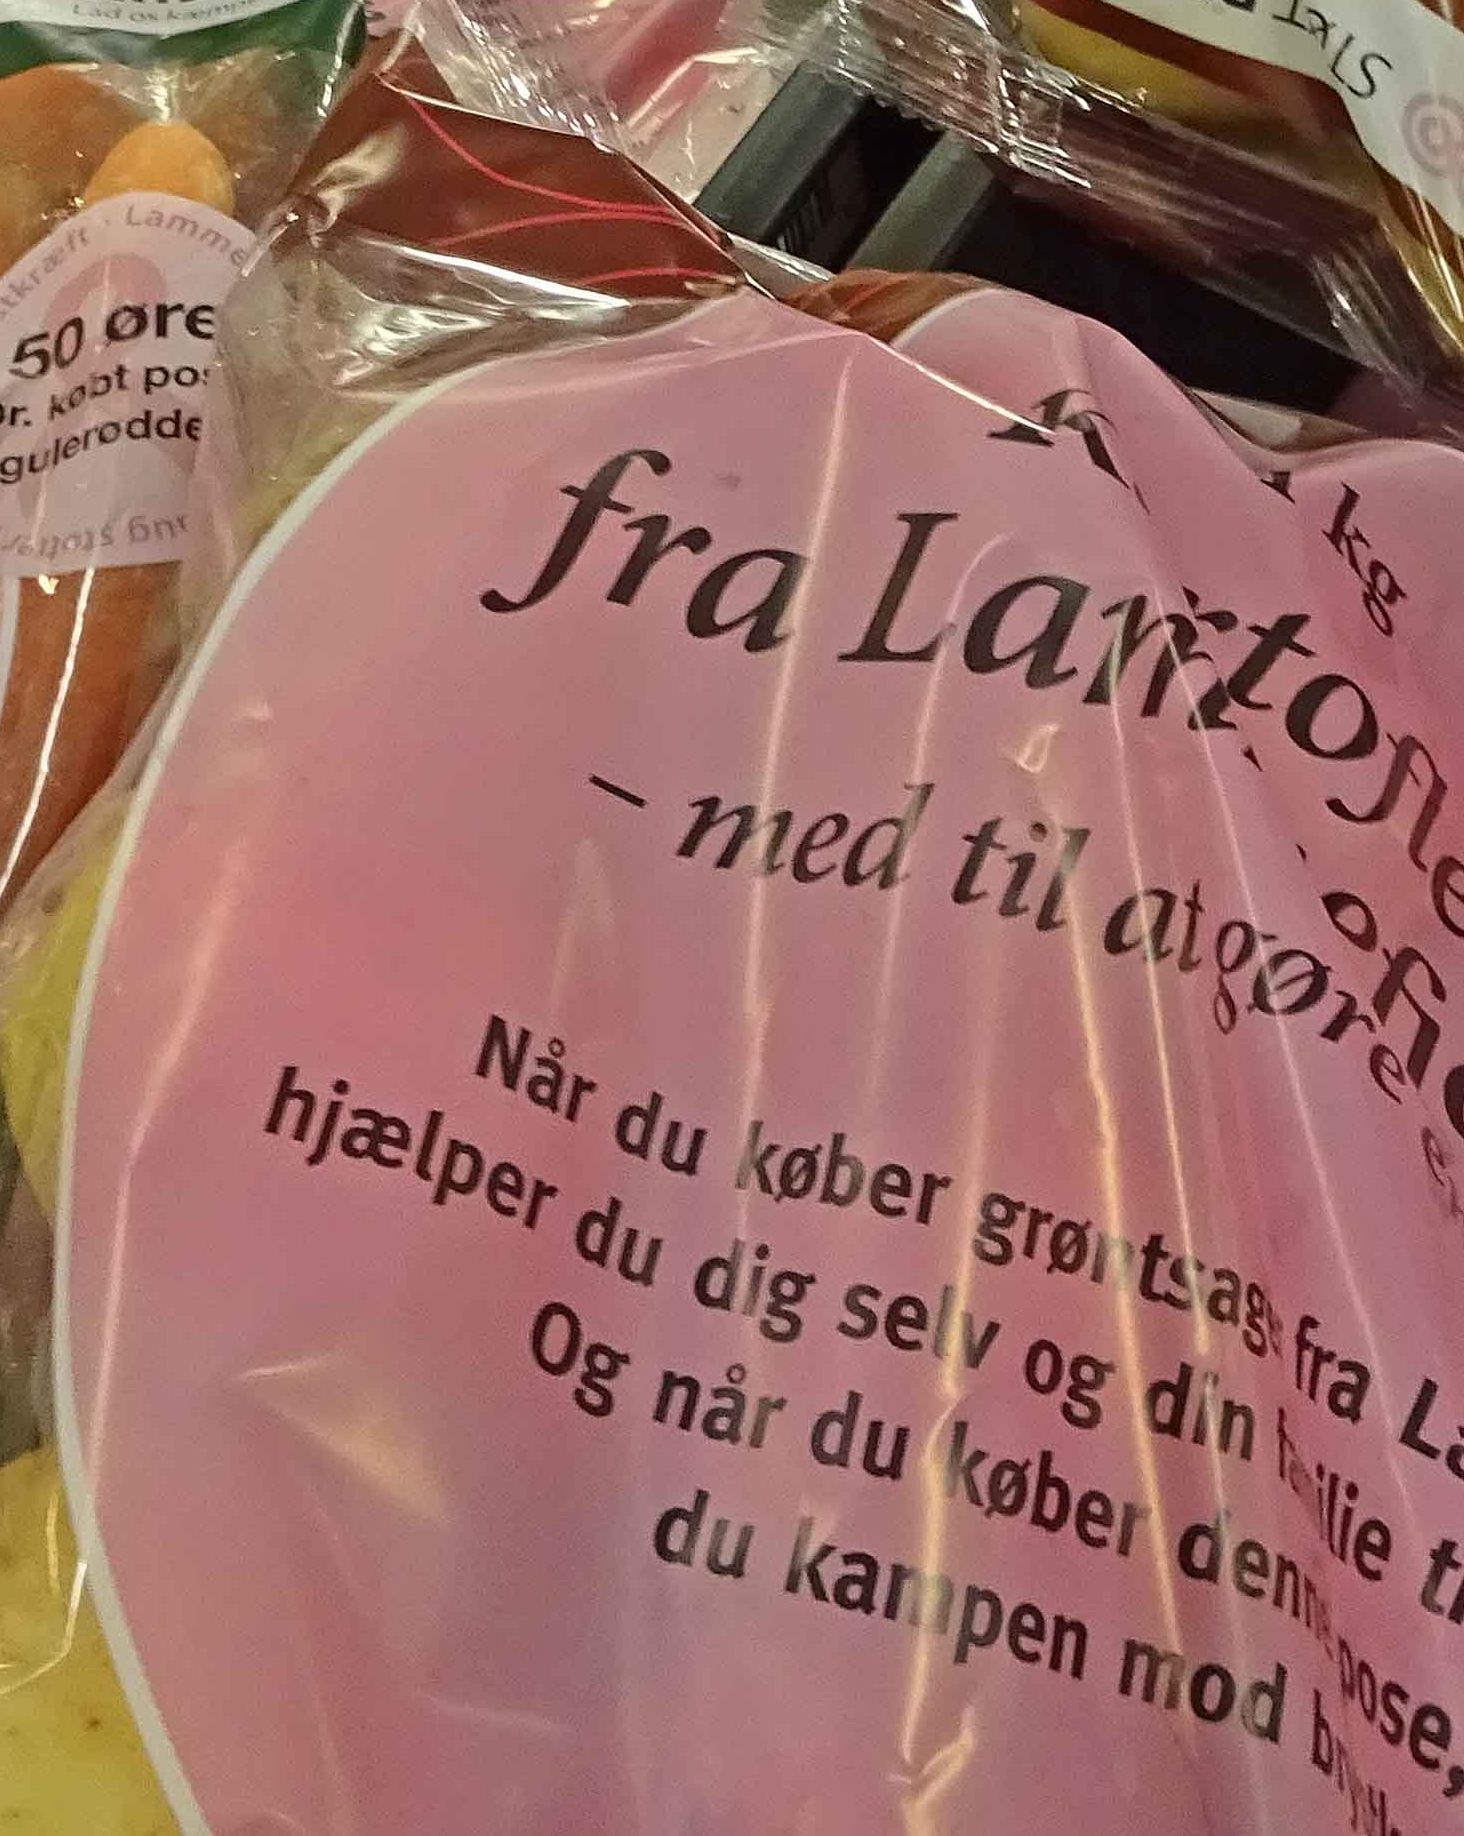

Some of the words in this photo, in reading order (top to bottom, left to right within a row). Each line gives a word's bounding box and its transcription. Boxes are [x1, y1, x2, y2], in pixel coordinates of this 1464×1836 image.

[8, 316, 84, 380] 50
[480, 448, 805, 655] fra
[674, 766, 936, 894] med
[949, 812, 1087, 936] til
[1101, 878, 1205, 973] at
[263, 1063, 562, 1230] hjælper
[573, 1195, 665, 1287] du
[691, 1237, 820, 1345] dig
[834, 1276, 1001, 1371] selv
[1020, 1334, 1117, 1432] og
[1142, 1359, 1260, 1463] din
[472, 1013, 600, 1125] Når
[611, 1091, 711, 1178] du
[734, 1118, 952, 1227] køber
[1293, 1313, 1373, 1426] fra
[528, 1299, 633, 1418] Og
[650, 1361, 785, 1450] når
[809, 1389, 912, 1481] du
[942, 1419, 1153, 1557] køber
[650, 1487, 757, 1582] du
[783, 1513, 1091, 1682] kampen
[1118, 1634, 1288, 1746] mod
